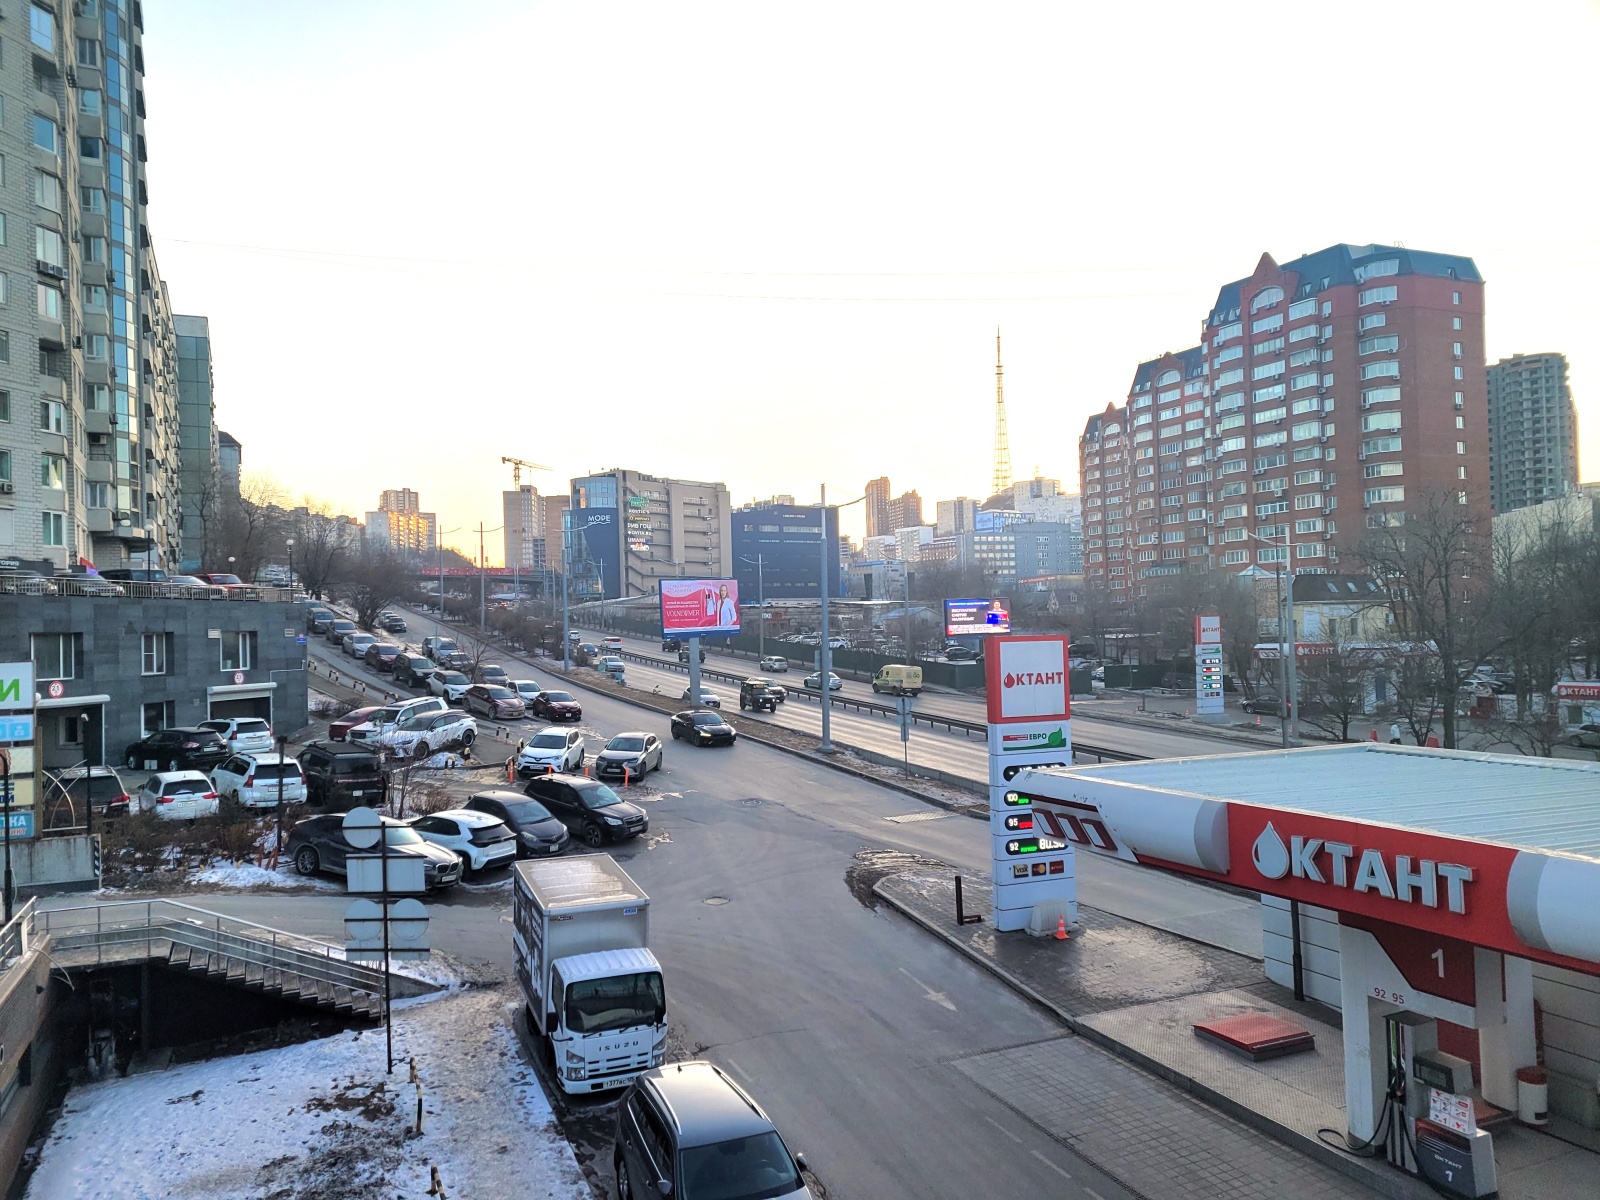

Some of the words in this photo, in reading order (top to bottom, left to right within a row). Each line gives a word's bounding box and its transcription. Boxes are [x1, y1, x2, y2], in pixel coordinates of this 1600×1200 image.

[1008, 818, 1019, 827] 95
[1009, 842, 1020, 852] 92
[1431, 948, 1445, 979] 1
[1374, 987, 1387, 999] 92
[1392, 993, 1405, 1005] 95
[599, 1041, 639, 1051] ISUZU
[1445, 1170, 1453, 1182] 1
